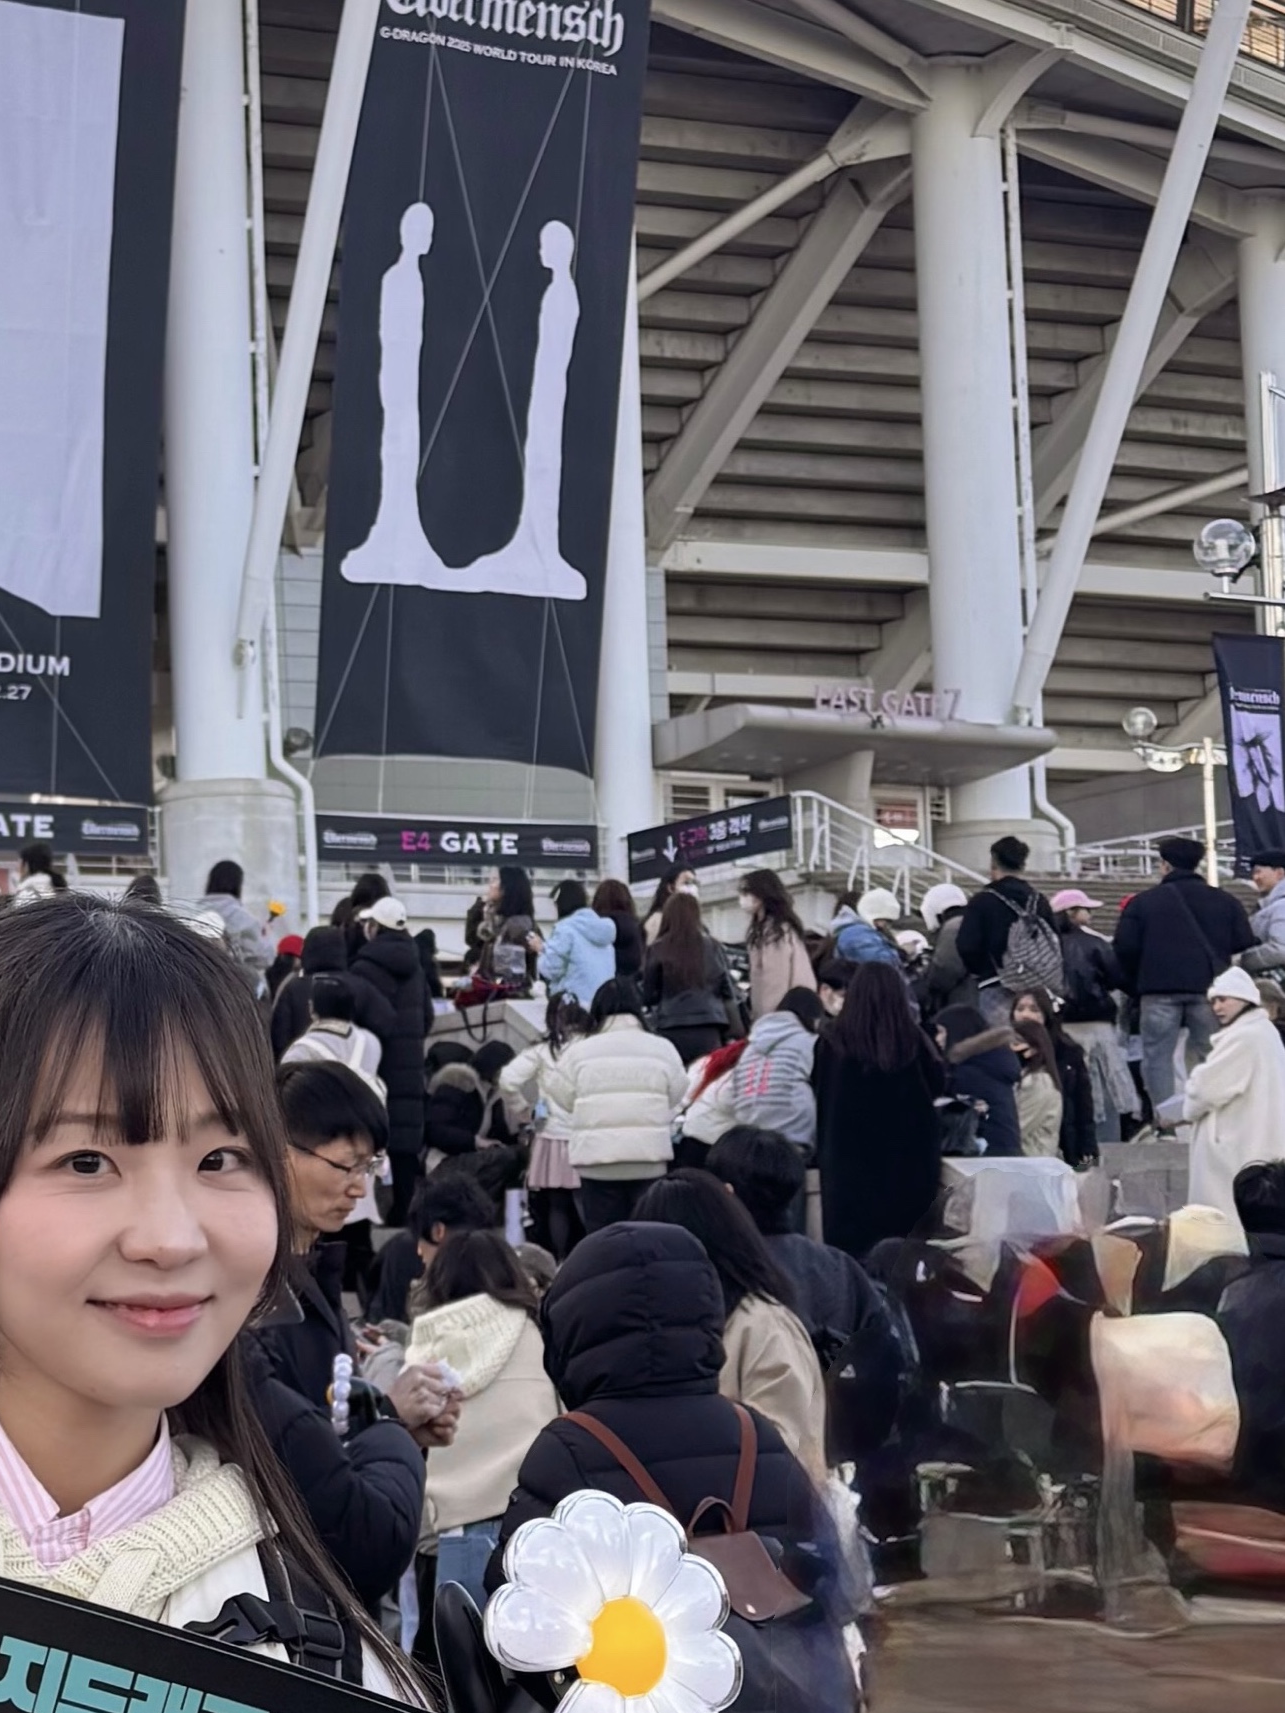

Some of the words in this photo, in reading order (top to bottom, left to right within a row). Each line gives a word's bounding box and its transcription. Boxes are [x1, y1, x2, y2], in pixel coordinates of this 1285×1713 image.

[472, 42, 518, 62] WORLD
[520, 50, 557, 67] TOUR
[559, 55, 576, 69] IN
[575, 57, 618, 76] KOREA
[400, 830, 431, 852] E4
[439, 831, 519, 855] GATE
